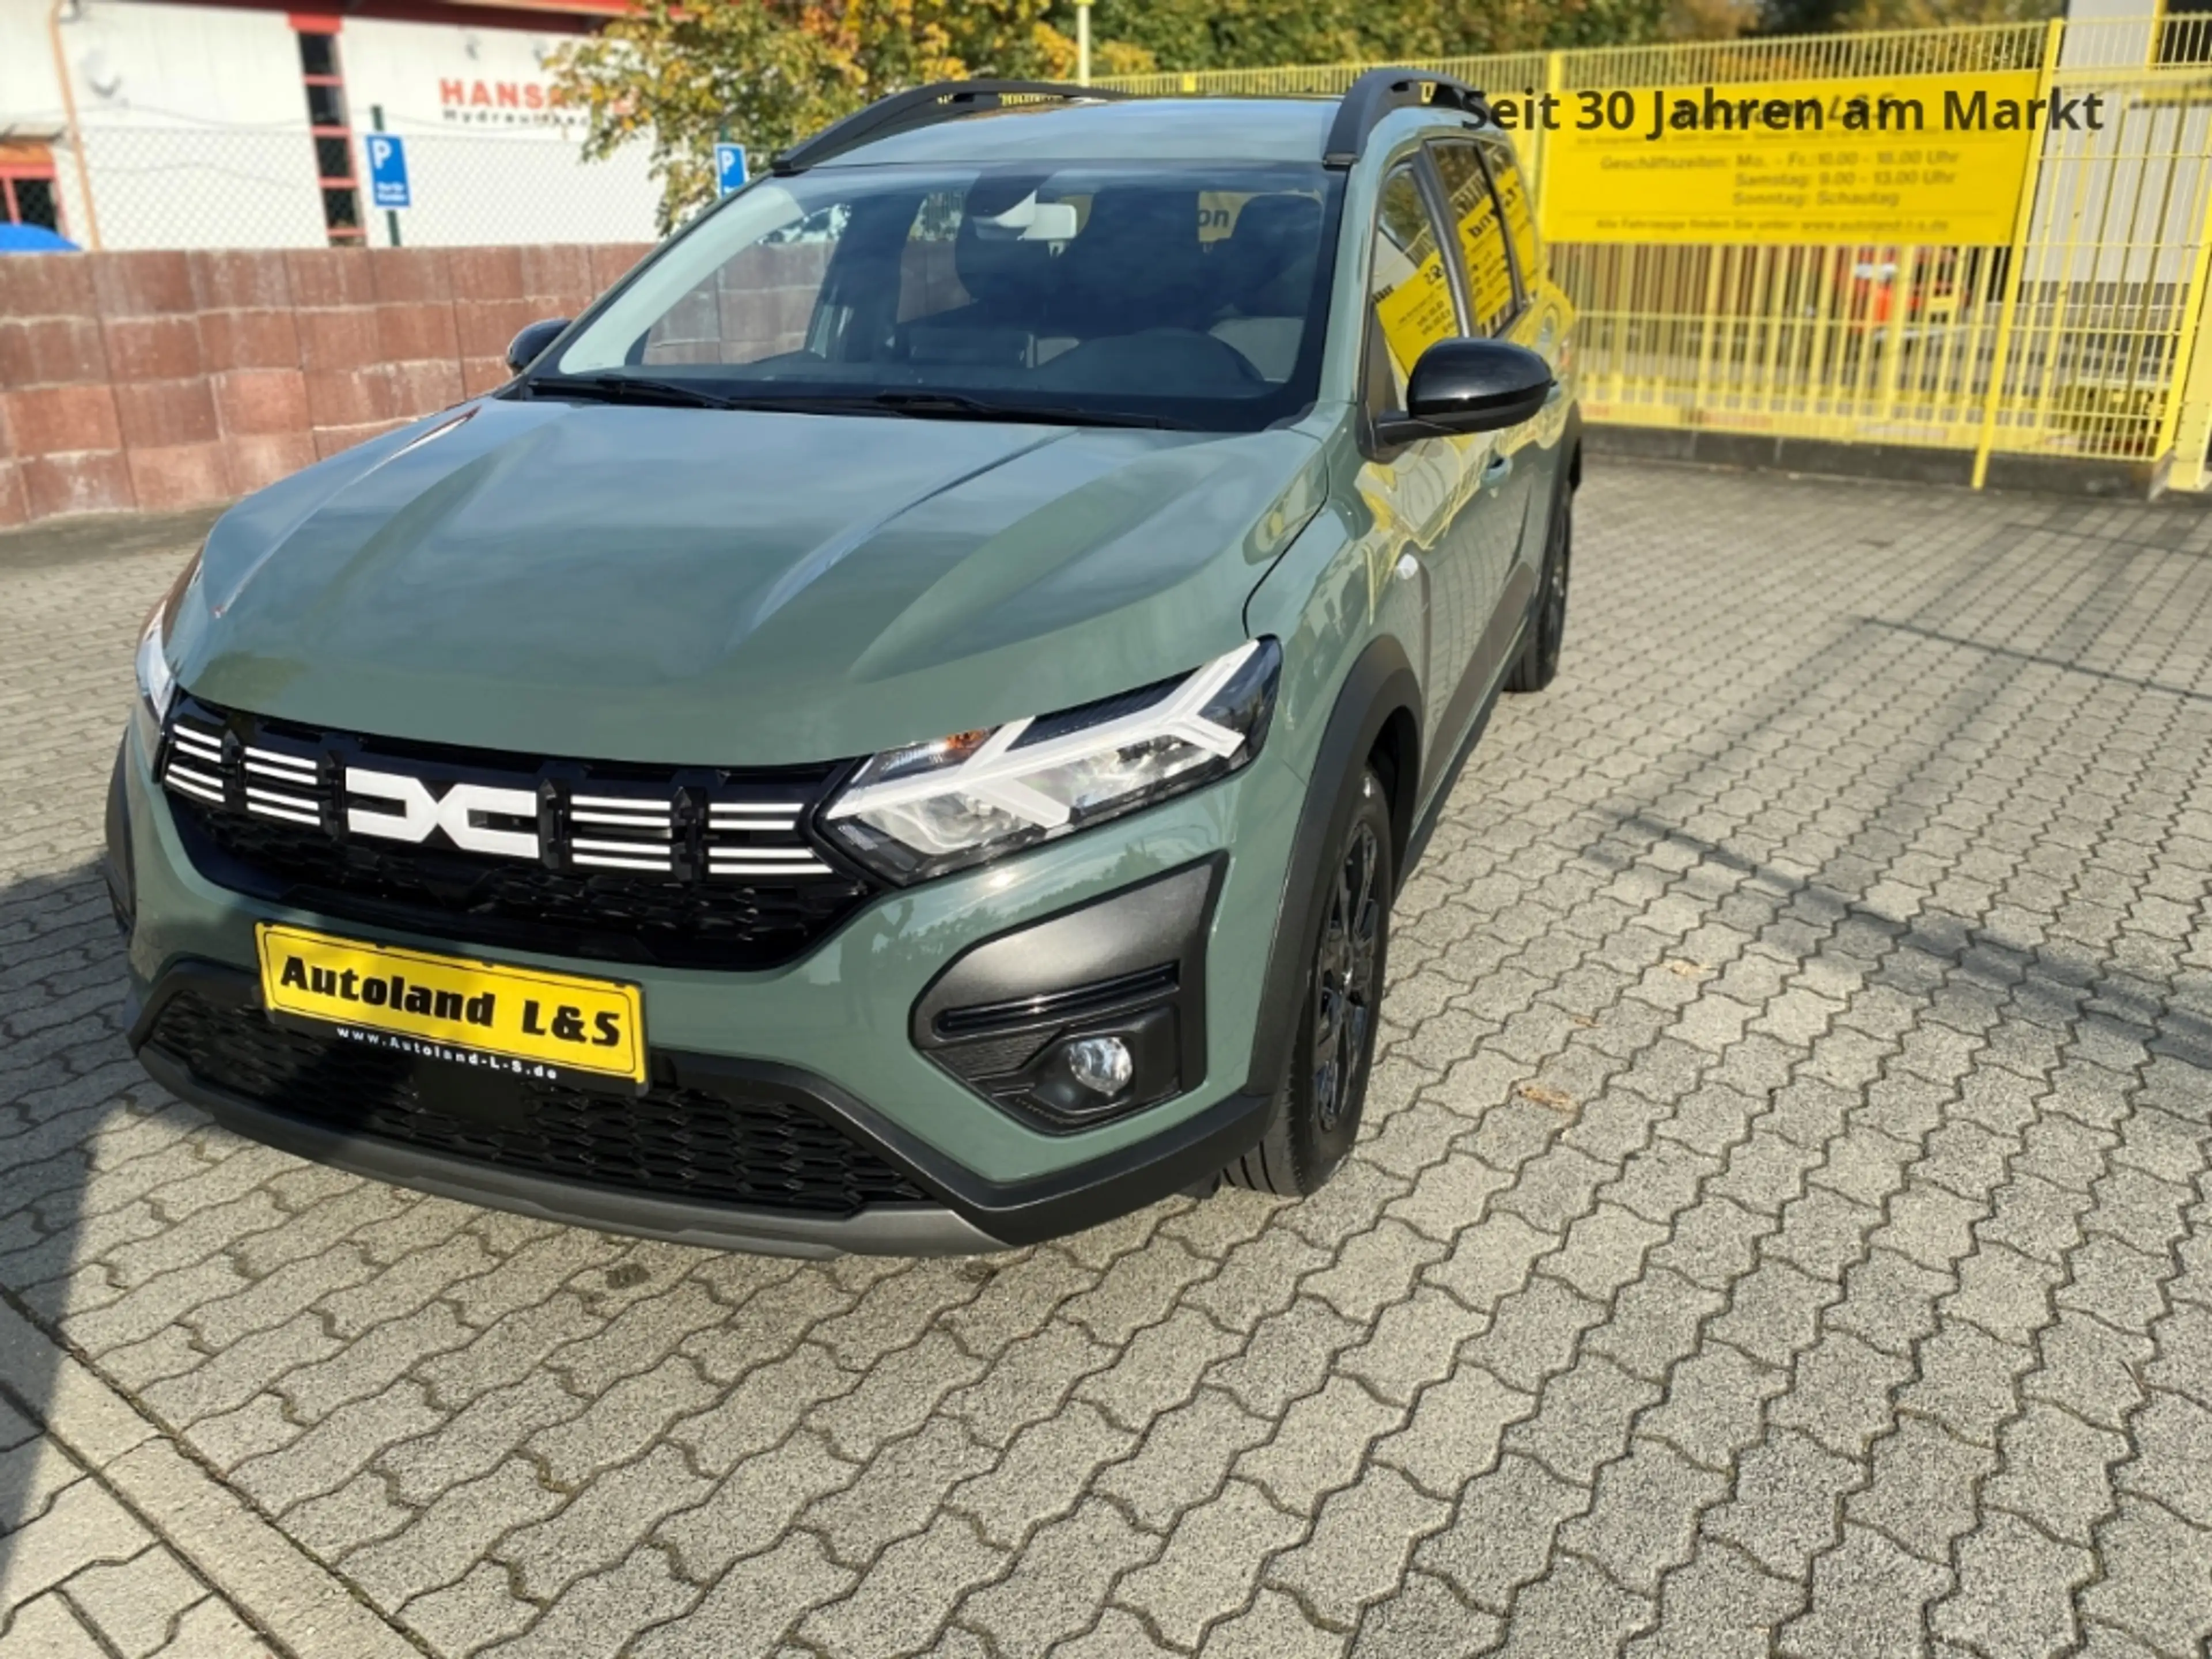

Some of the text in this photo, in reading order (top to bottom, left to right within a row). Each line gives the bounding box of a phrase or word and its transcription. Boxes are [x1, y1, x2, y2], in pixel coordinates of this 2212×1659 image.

[373, 139, 392, 169] P
[721, 150, 736, 175] P
[1926, 149, 1960, 165] Uhr
[1922, 169, 1957, 185] Uhr
[280, 954, 622, 1048] Autoland L&S
[336, 1026, 558, 1080] www.Autoland-L-S.de
